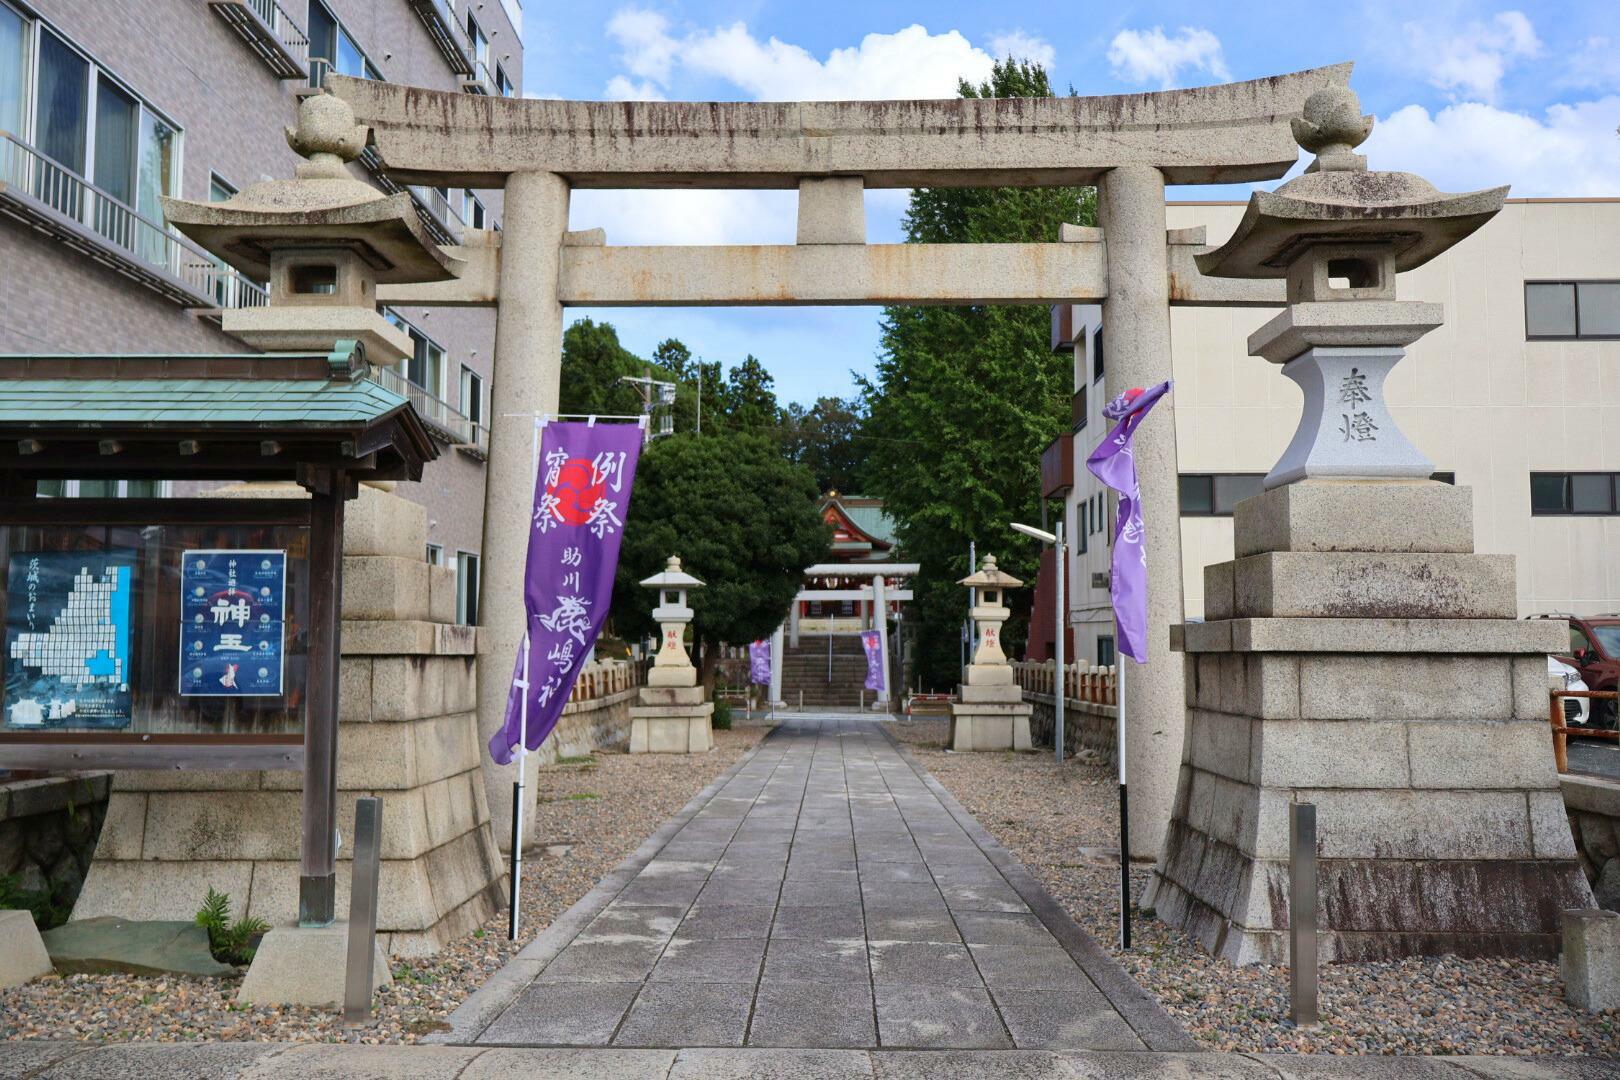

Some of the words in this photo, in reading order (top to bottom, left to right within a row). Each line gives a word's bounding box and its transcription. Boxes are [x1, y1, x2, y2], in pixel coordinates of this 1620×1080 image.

[1338, 367, 1380, 443] 奉燈
[534, 446, 569, 534] 宵祭
[585, 451, 627, 540] 例祭
[26, 557, 40, 631] 茨城のおまいり
